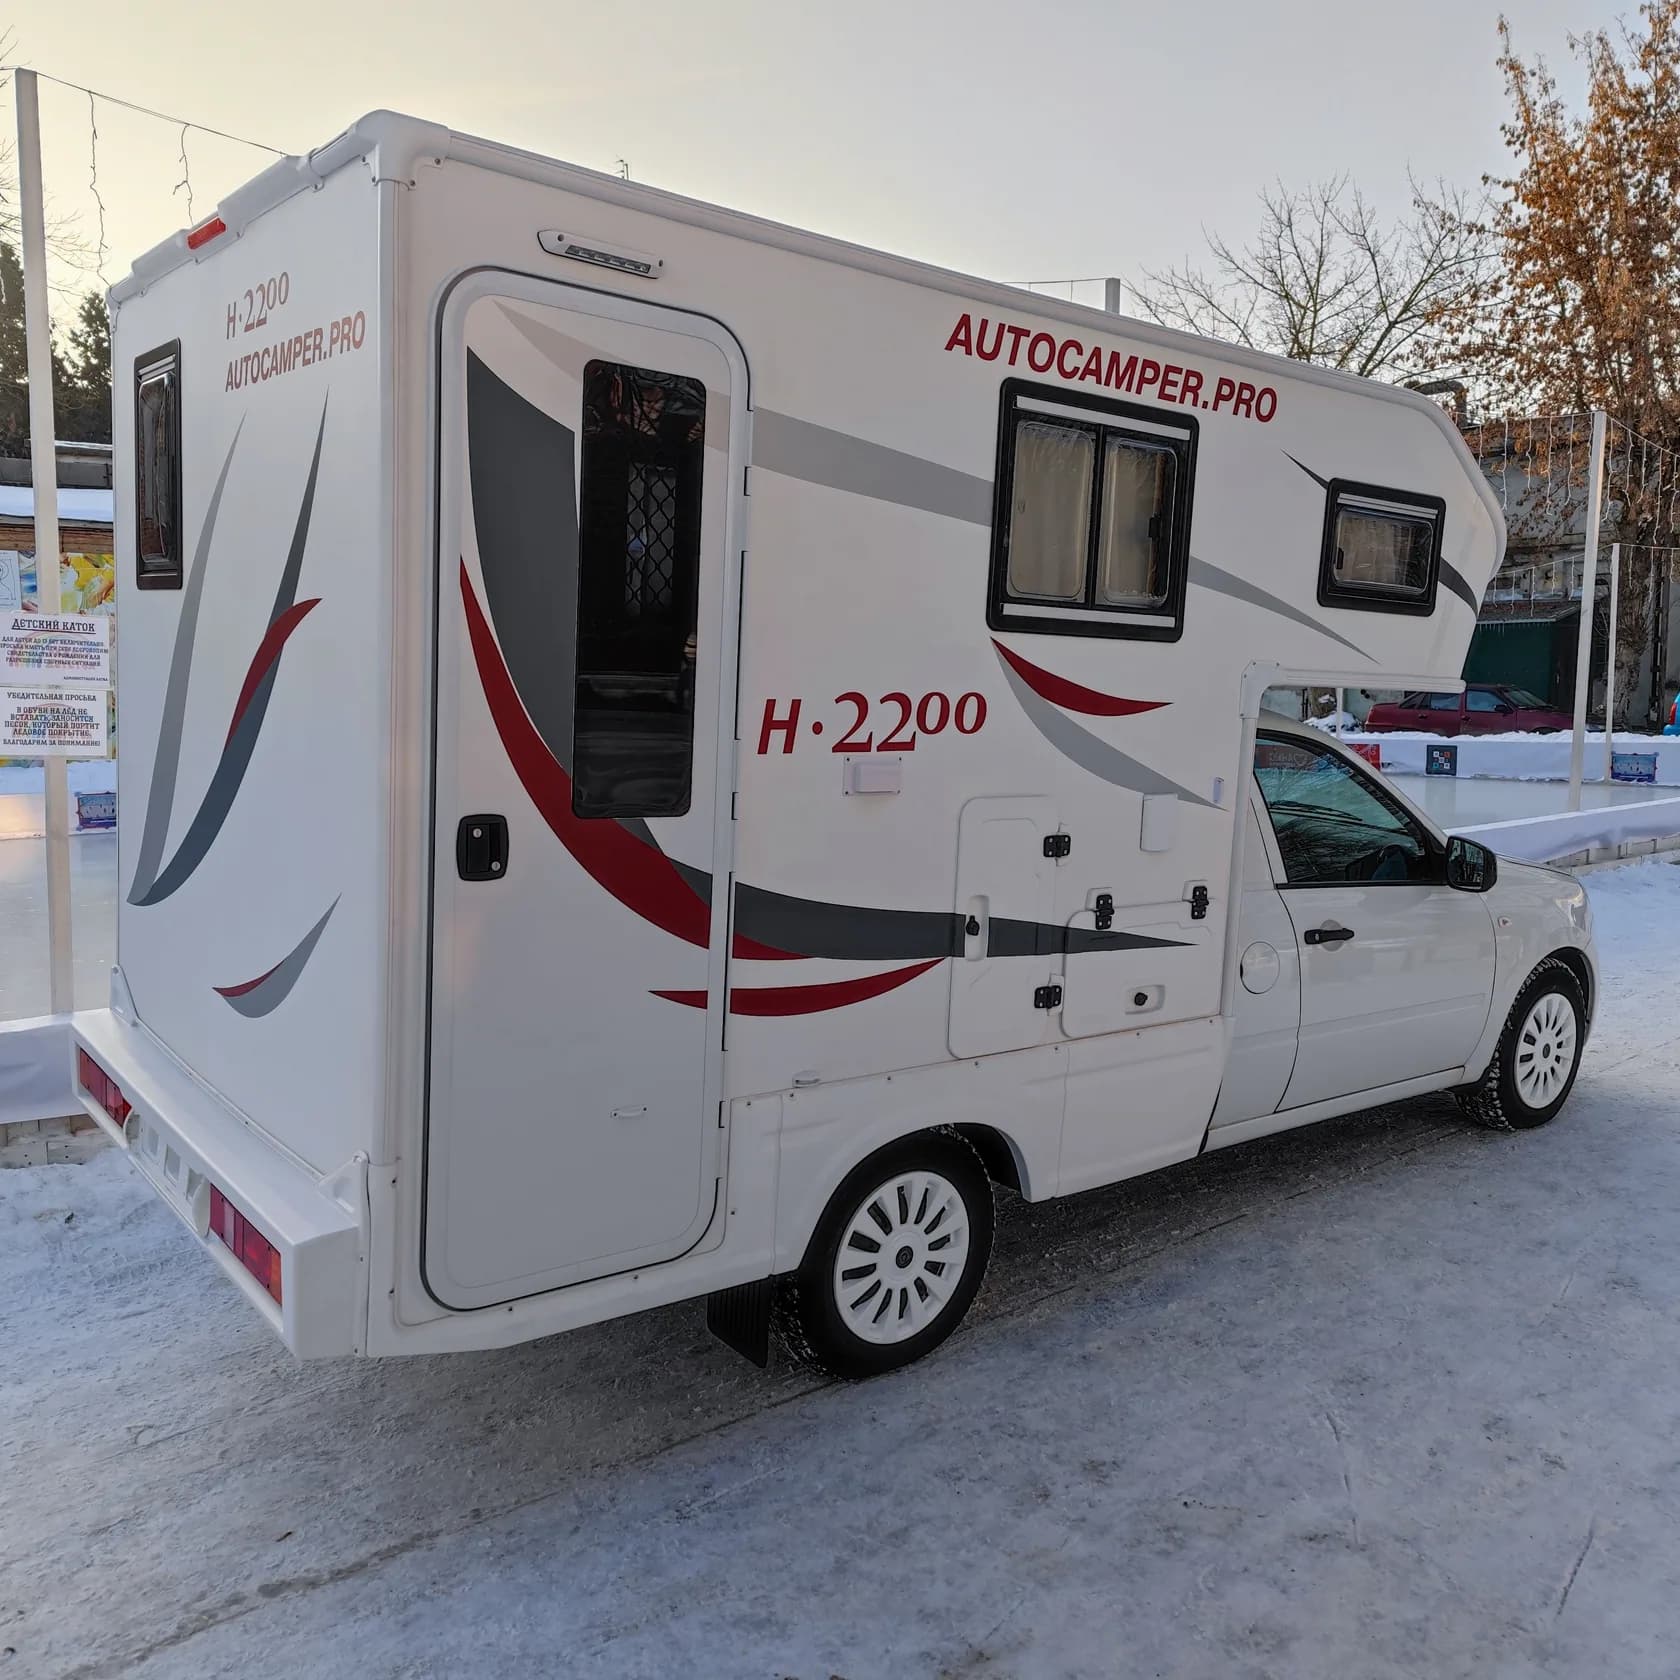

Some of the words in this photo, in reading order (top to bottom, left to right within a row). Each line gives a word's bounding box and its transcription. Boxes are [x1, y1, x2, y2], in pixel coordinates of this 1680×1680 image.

[225, 310, 366, 393] AUTOCAMPER.PRO
[944, 313, 1278, 423] AUTOCAMPER.PRO
[11, 618, 60, 630] ДЕТСКИЙ
[62, 621, 95, 632] КАТОК
[7, 691, 63, 701] УБЕДИТЕЛЬНАЯ
[64, 693, 97, 702] ПРОСЬБА
